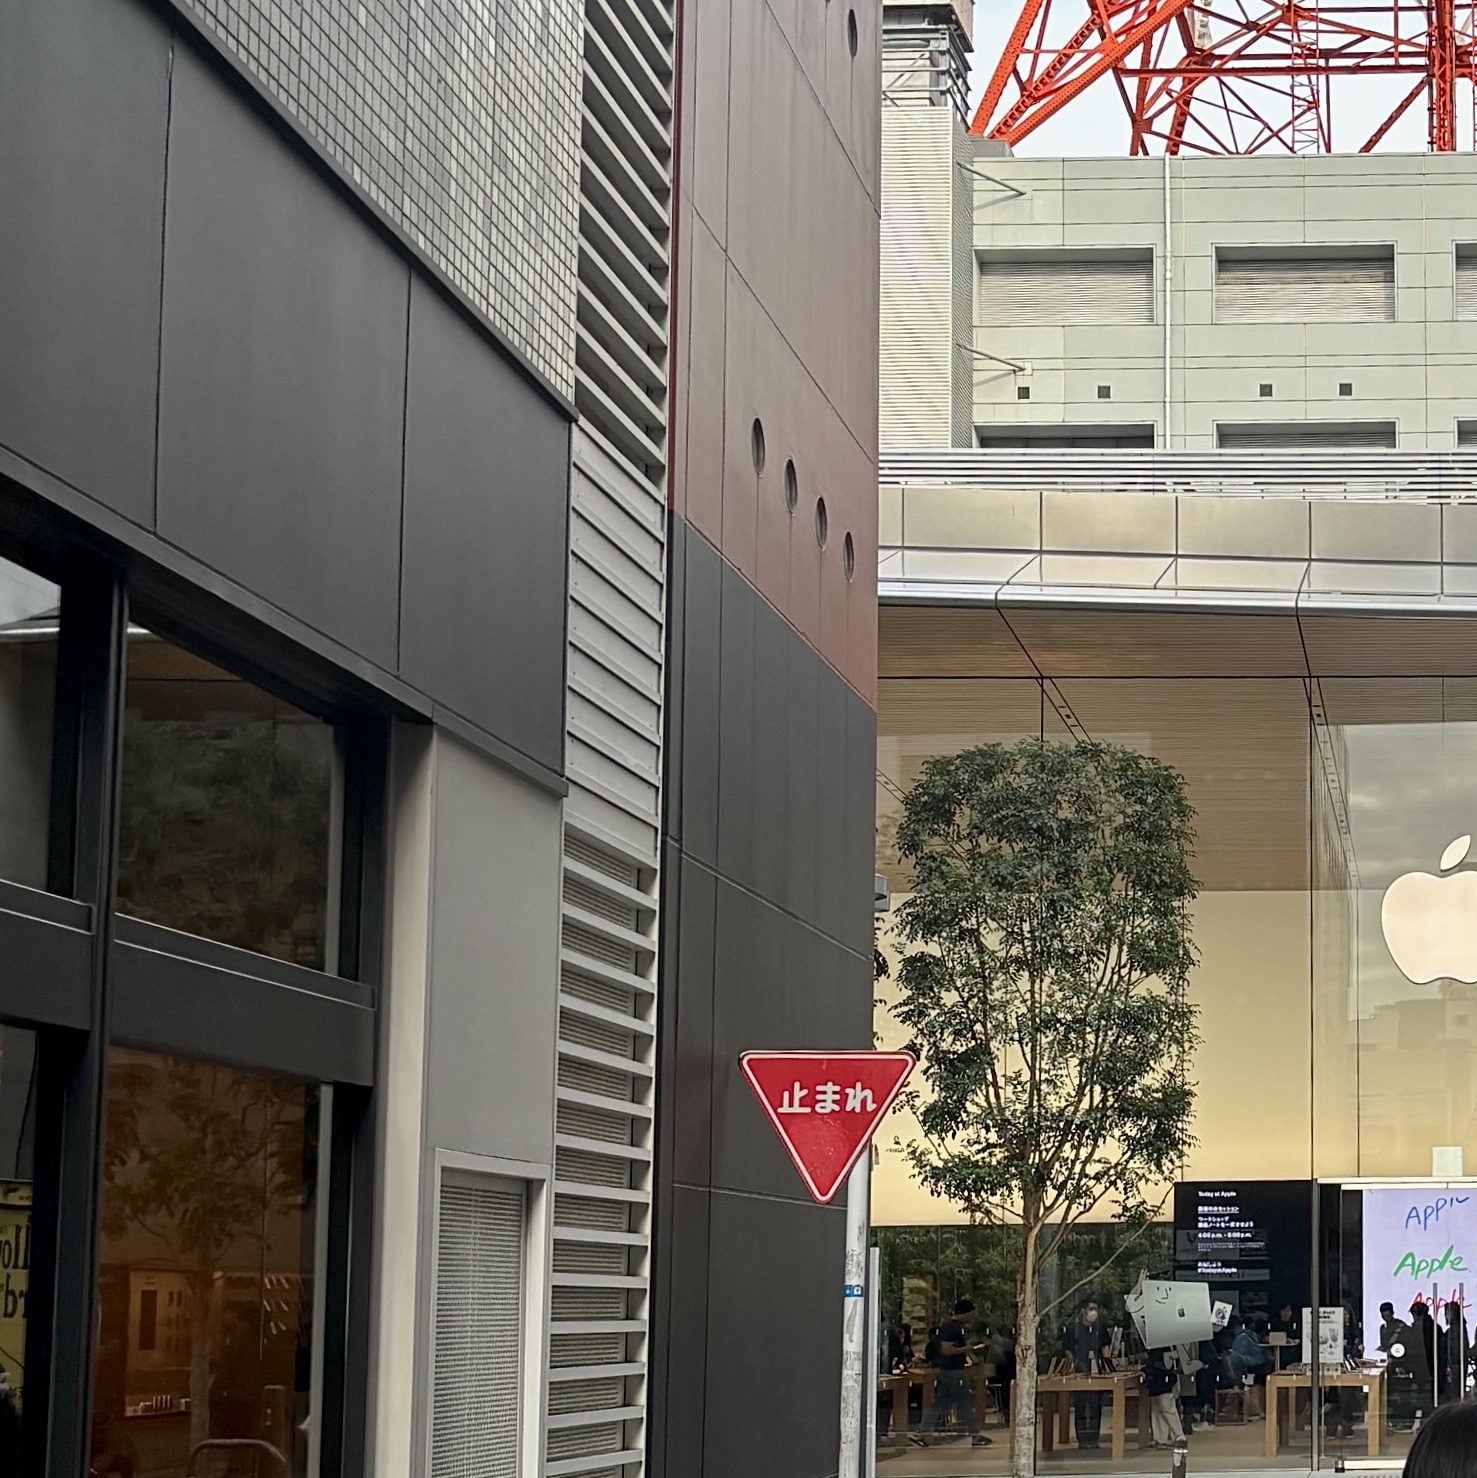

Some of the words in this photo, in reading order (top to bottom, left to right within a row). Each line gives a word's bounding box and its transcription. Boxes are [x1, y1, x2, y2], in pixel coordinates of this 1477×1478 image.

[777, 1081, 877, 1114] 止まれ
[1393, 1245, 1469, 1280] Apple
